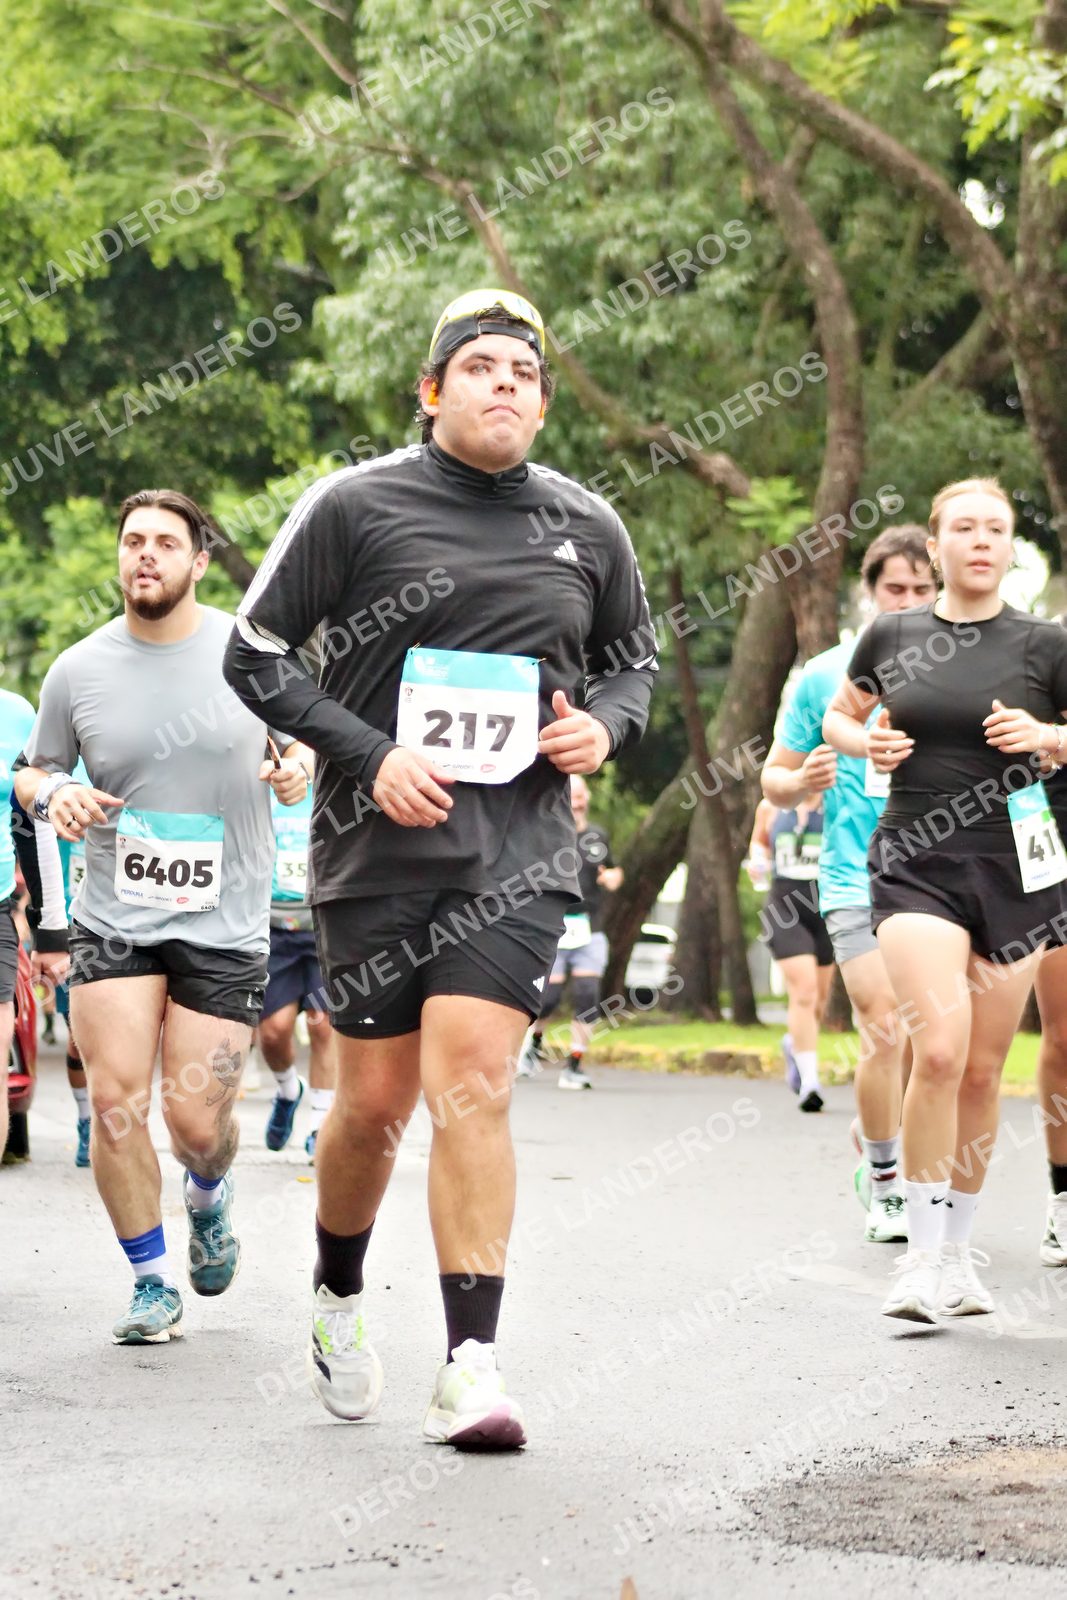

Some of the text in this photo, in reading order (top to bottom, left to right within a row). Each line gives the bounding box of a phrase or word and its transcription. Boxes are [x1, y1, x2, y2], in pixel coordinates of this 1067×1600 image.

[422, 709, 516, 752] 217
[1028, 829, 1056, 862] 41
[124, 853, 214, 889] 6405
